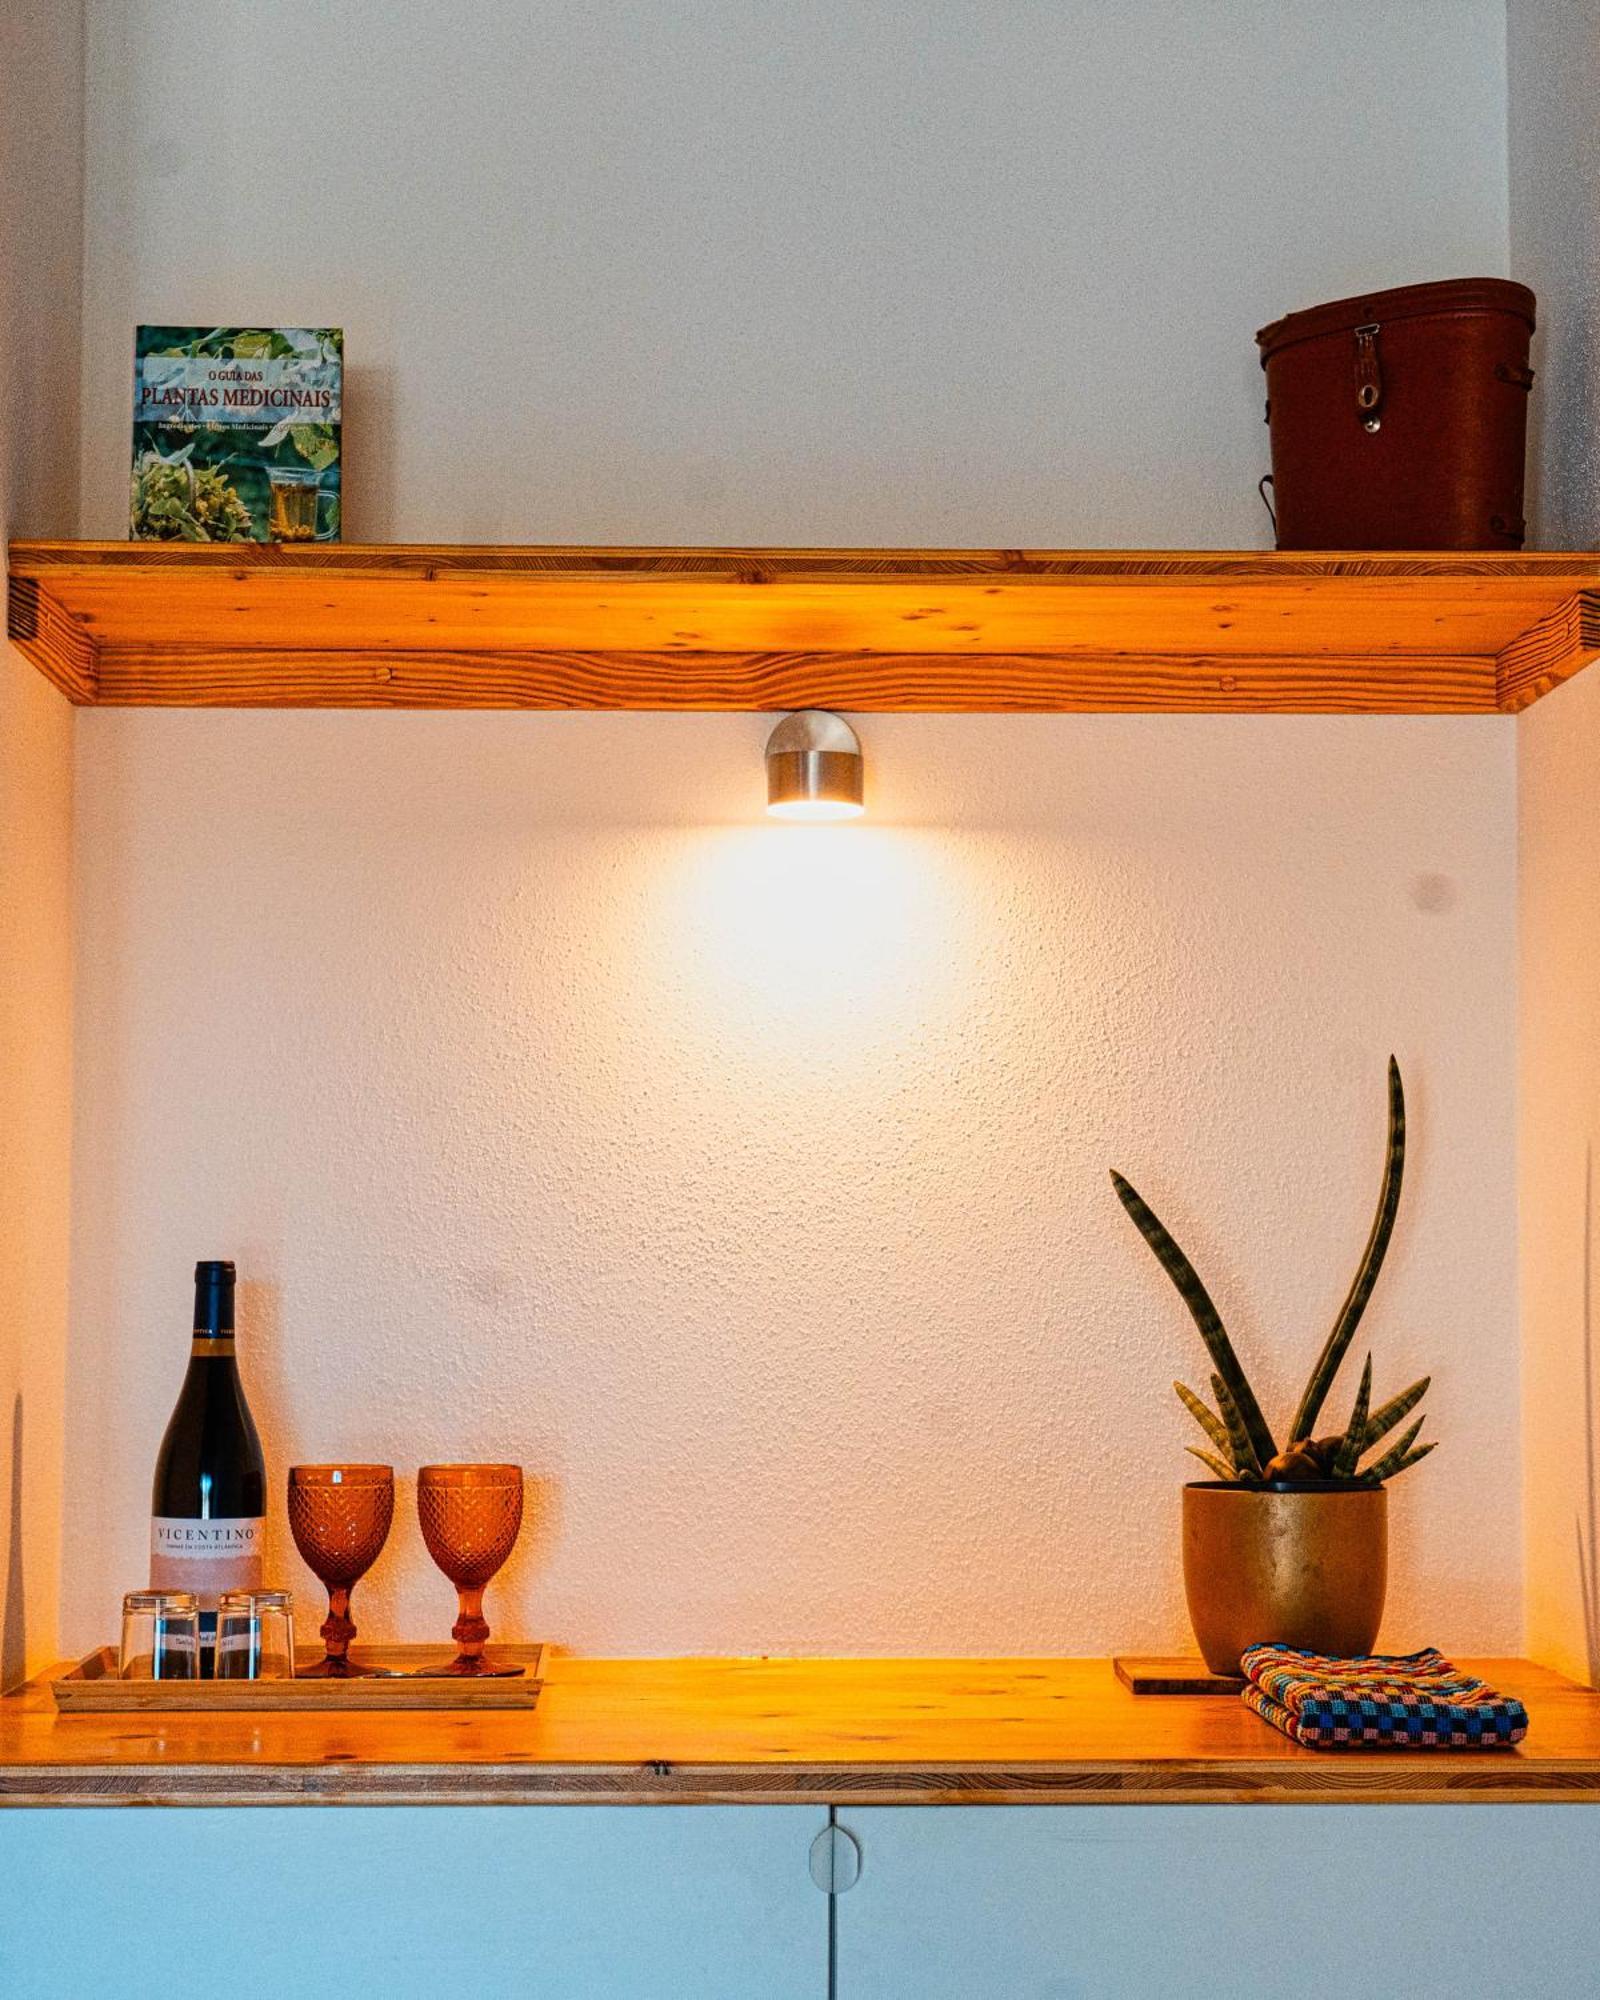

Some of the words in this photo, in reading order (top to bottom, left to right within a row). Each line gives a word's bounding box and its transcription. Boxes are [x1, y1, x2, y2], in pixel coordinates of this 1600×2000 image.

[208, 370, 217, 381] O
[244, 370, 264, 382] DAS
[141, 387, 218, 406] PLANTAS
[222, 388, 331, 408] MEDICINAIS
[158, 1527, 255, 1541] VICENTINO
